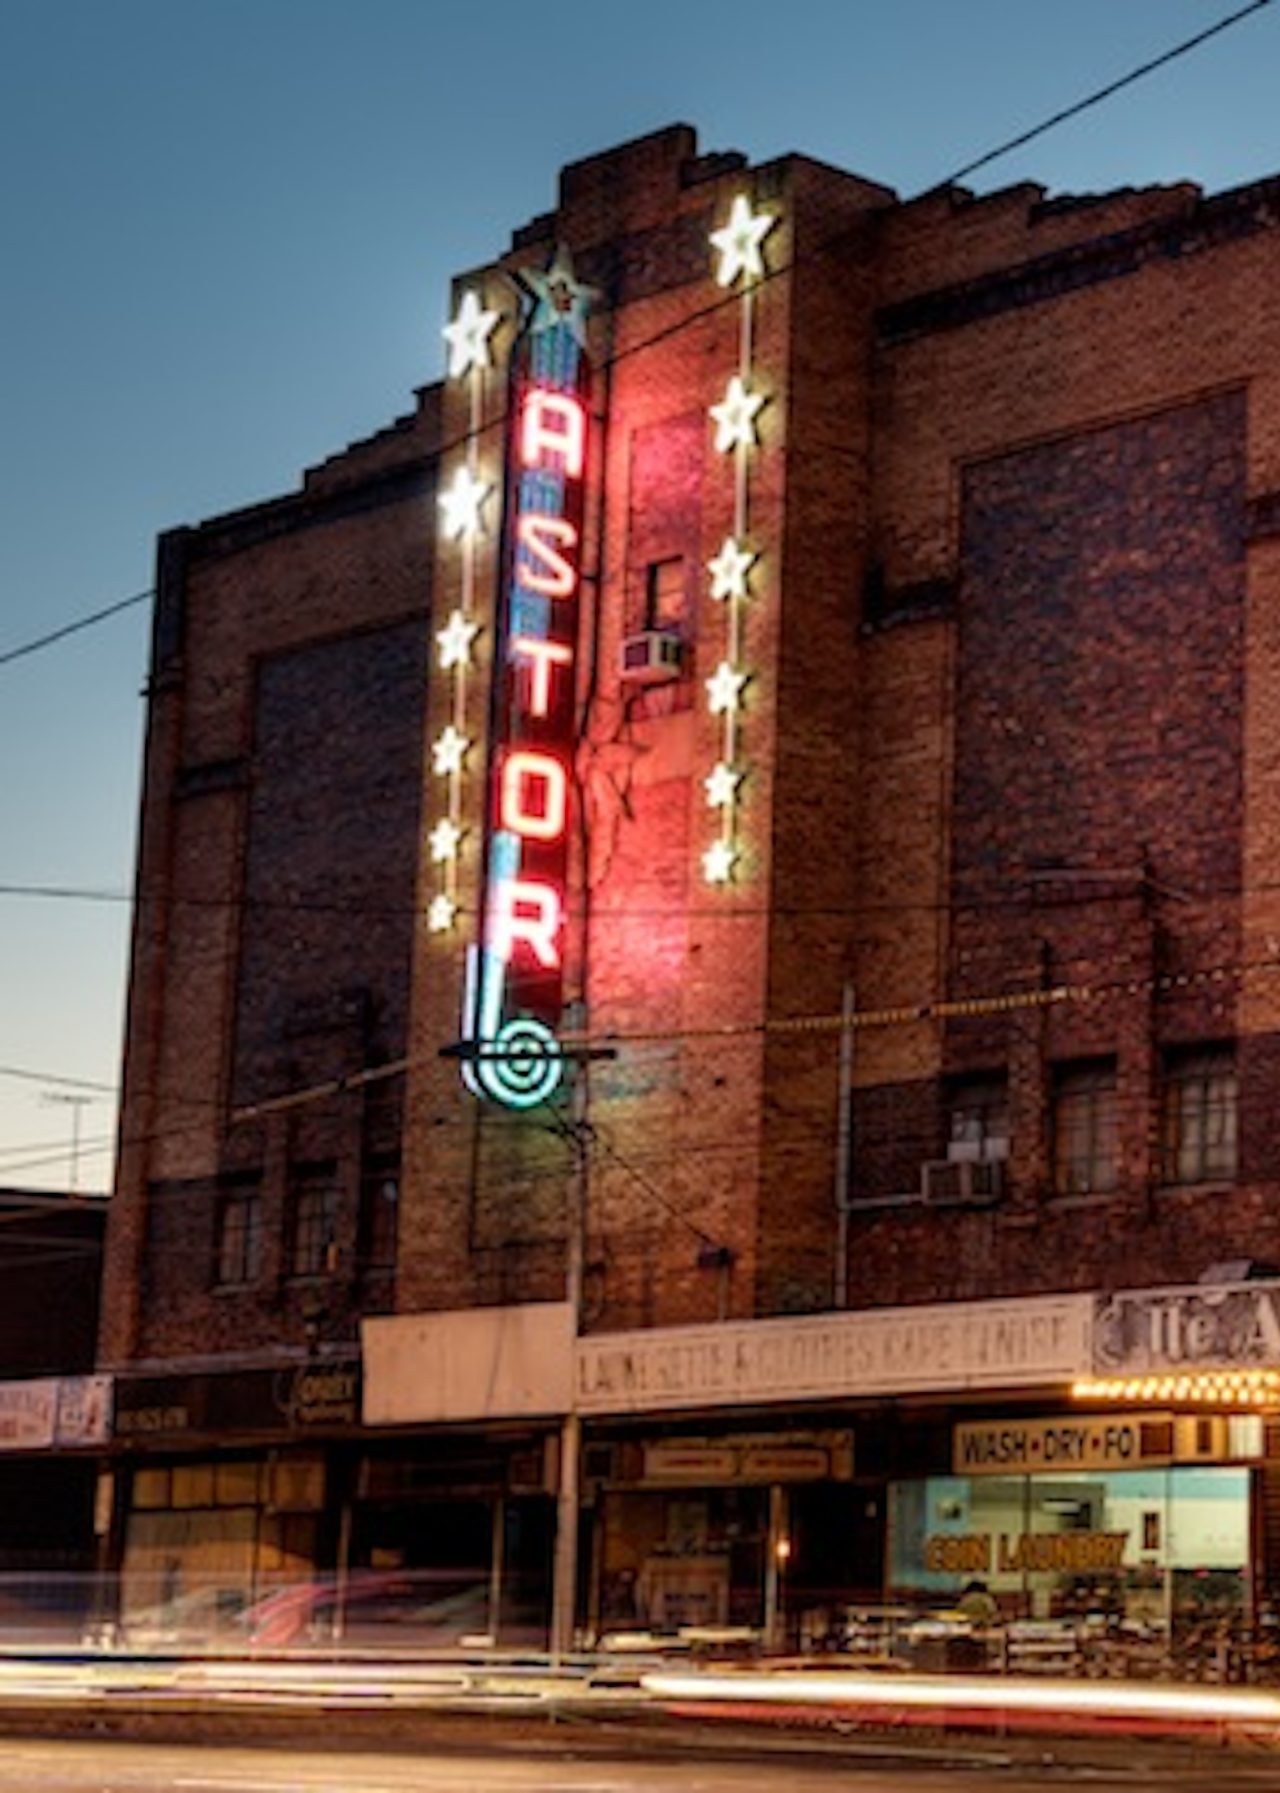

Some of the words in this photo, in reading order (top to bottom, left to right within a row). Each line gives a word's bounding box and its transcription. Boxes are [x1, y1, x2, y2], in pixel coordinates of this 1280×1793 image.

[499, 387, 585, 968] ASTOR
[962, 1429, 1027, 1464] WASH
[1043, 1426, 1088, 1461] DRY
[927, 1532, 992, 1573] COIN
[998, 1531, 1130, 1573] LAUNDRY
